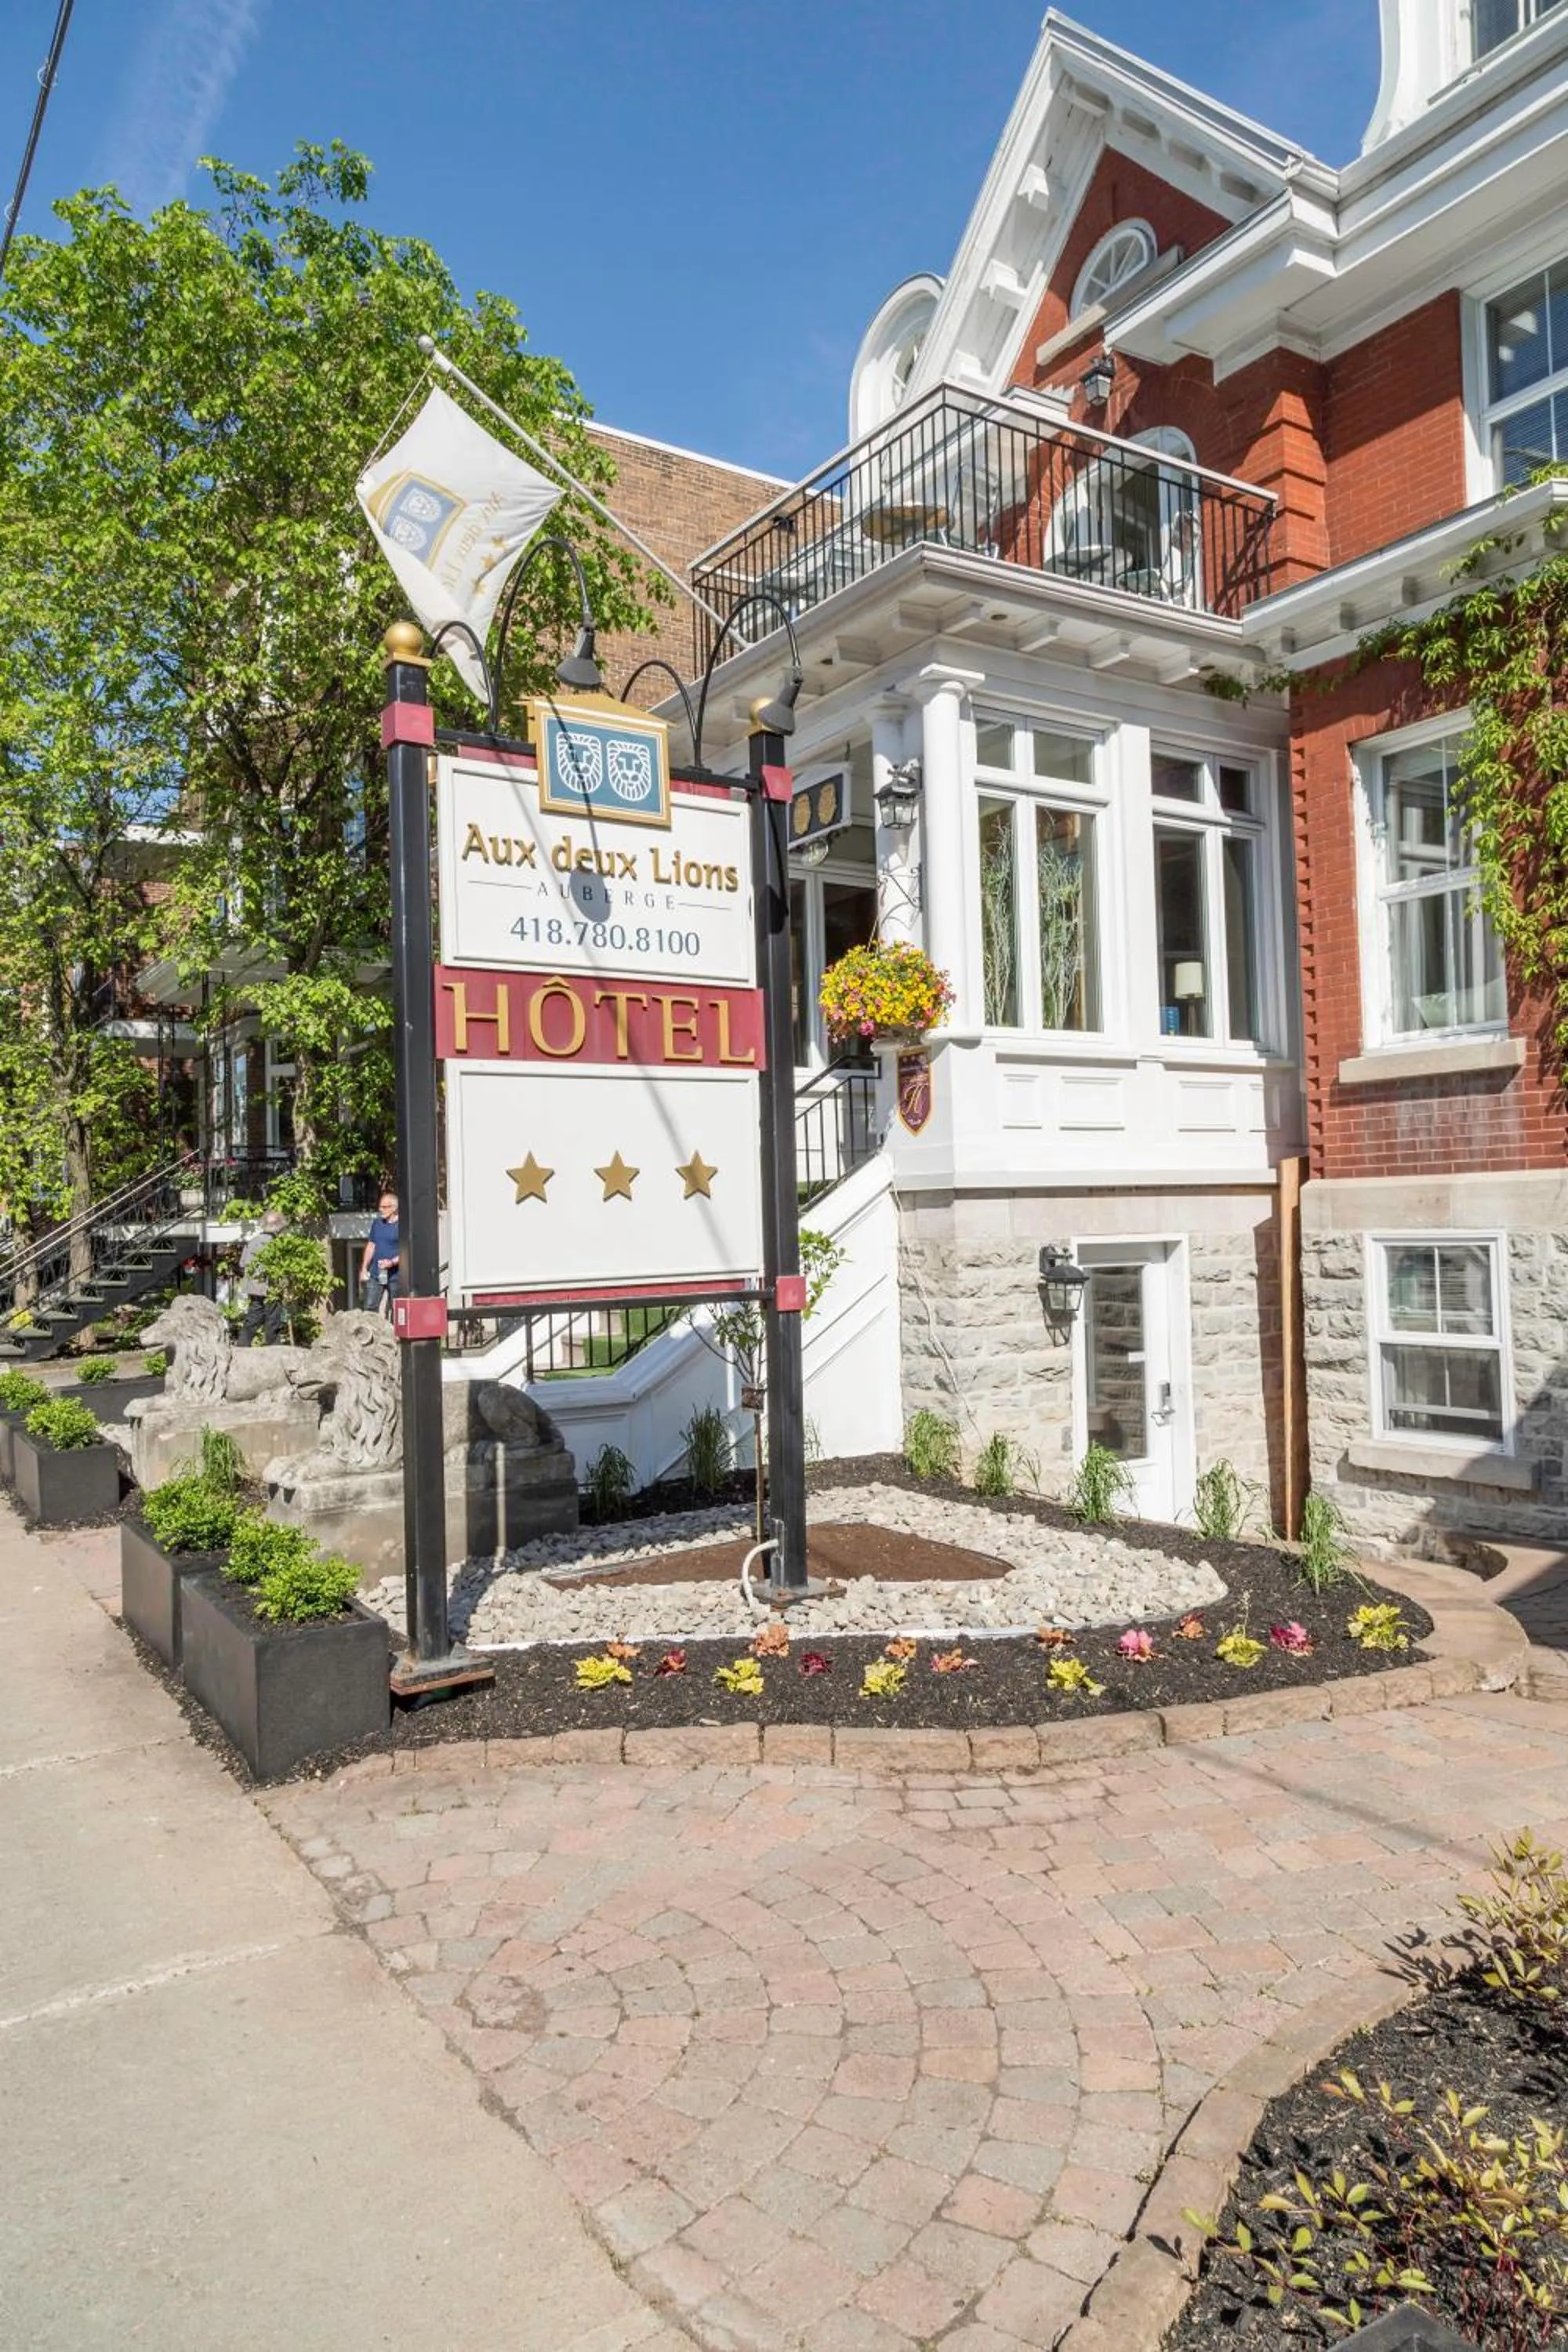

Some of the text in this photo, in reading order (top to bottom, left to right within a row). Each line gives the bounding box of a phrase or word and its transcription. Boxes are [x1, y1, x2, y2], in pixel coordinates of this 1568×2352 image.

[462, 822, 739, 892] Aux deux Lions
[537, 882, 675, 910] AUBERGE
[510, 916, 701, 956] 418.780.8100
[442, 976, 756, 1064] HÔTEL
